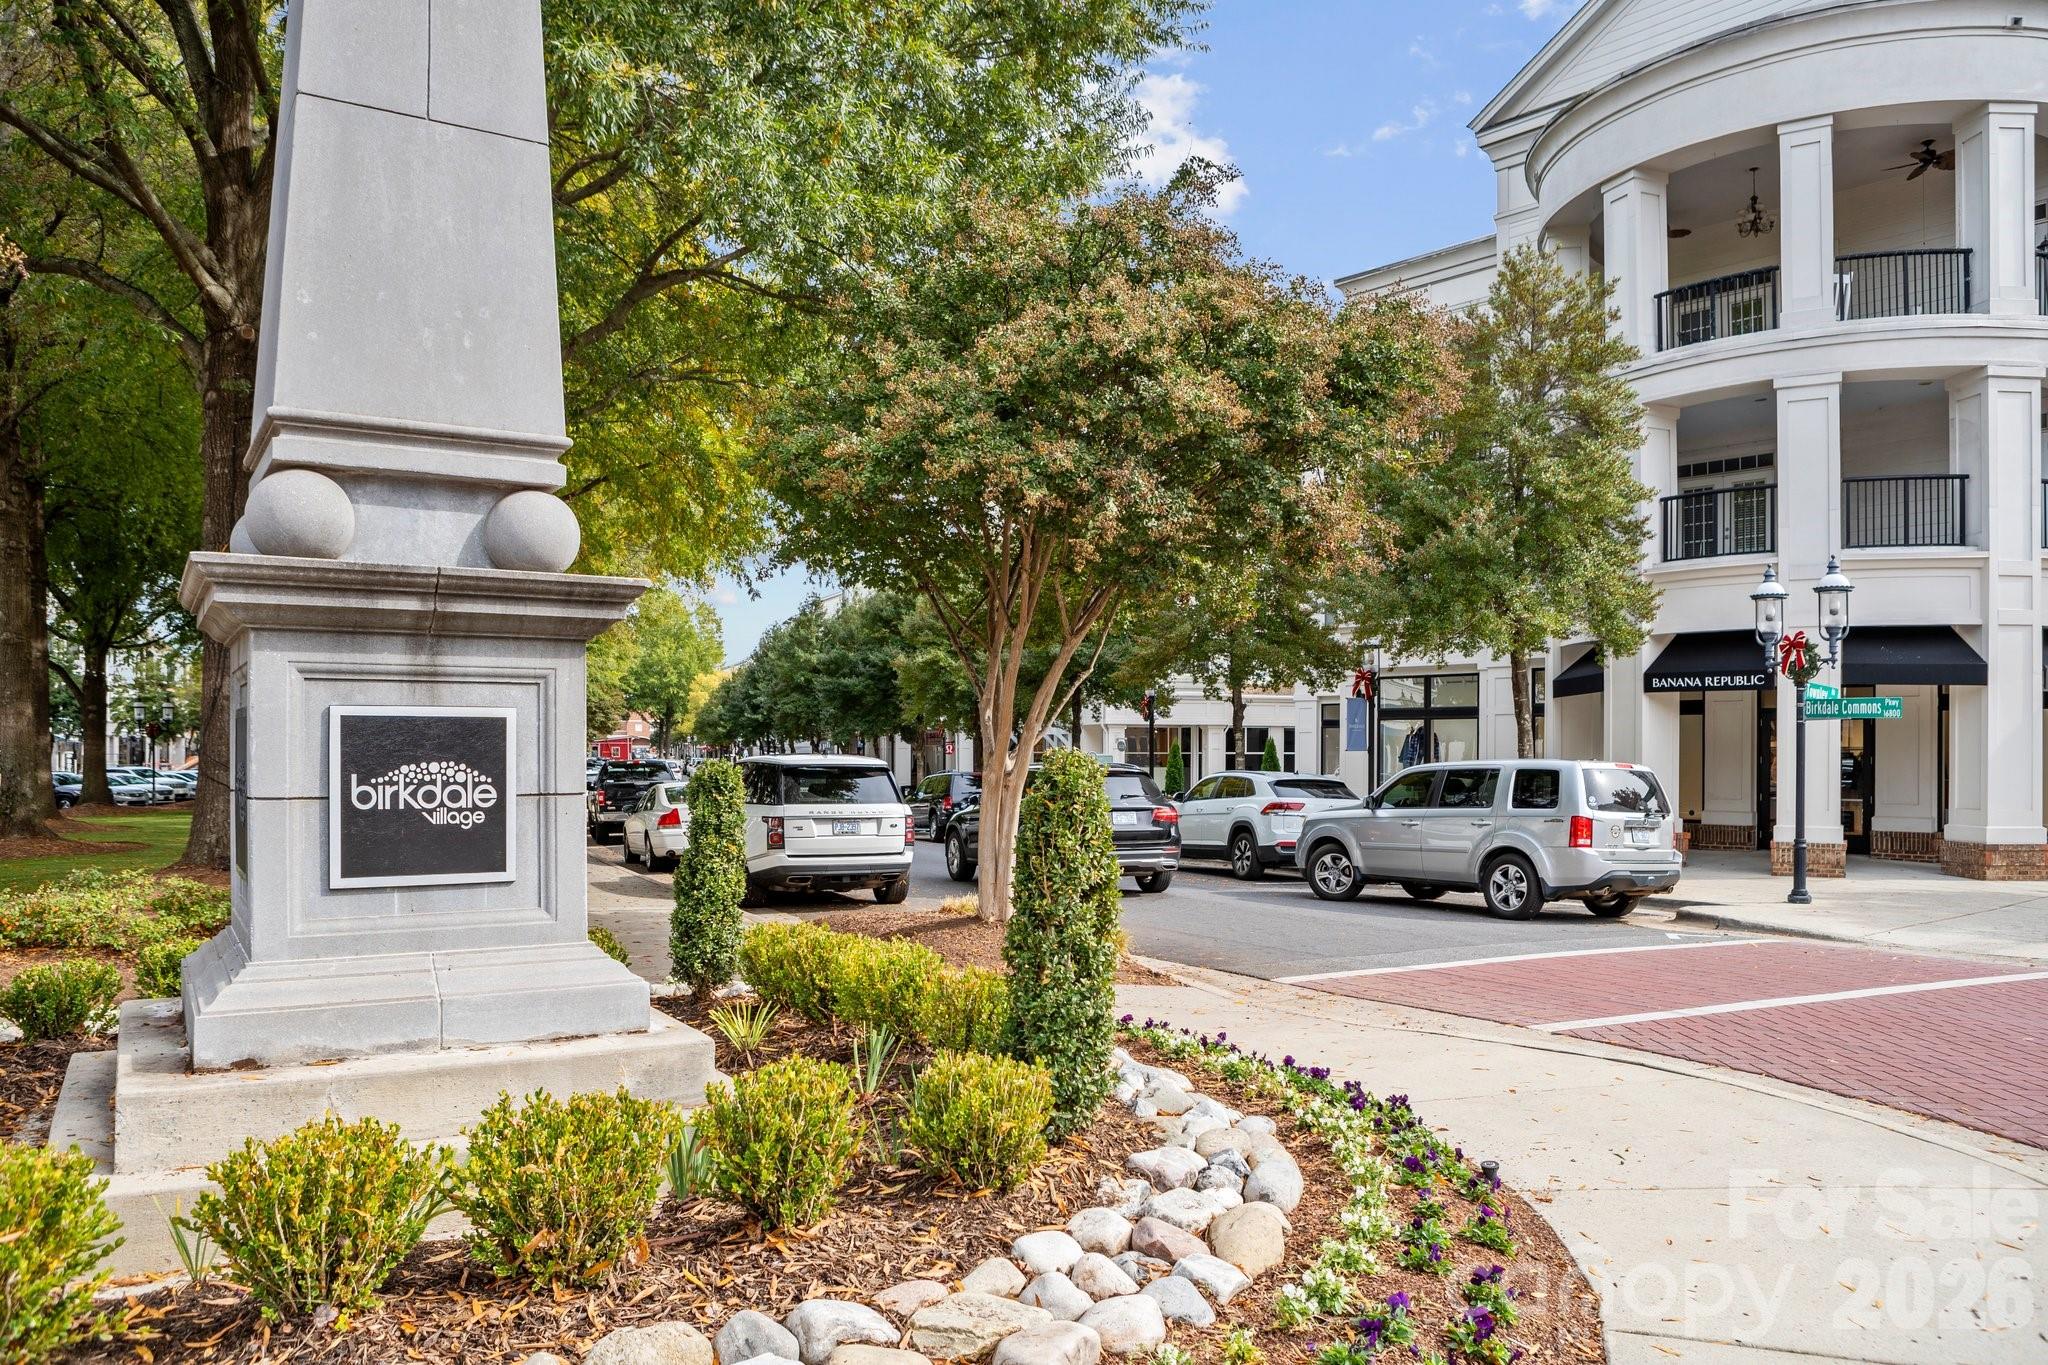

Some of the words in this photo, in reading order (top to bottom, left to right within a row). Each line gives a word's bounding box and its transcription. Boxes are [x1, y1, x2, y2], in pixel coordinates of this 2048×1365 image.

[1652, 677, 1702, 688] BANANA
[1705, 674, 1765, 687] REPUBLIC
[1806, 701, 1839, 715] Birkdale
[1842, 700, 1882, 715] Commons
[1884, 698, 1900, 707] Pkwy
[351, 773, 498, 810] birkdale
[422, 807, 486, 830] village
